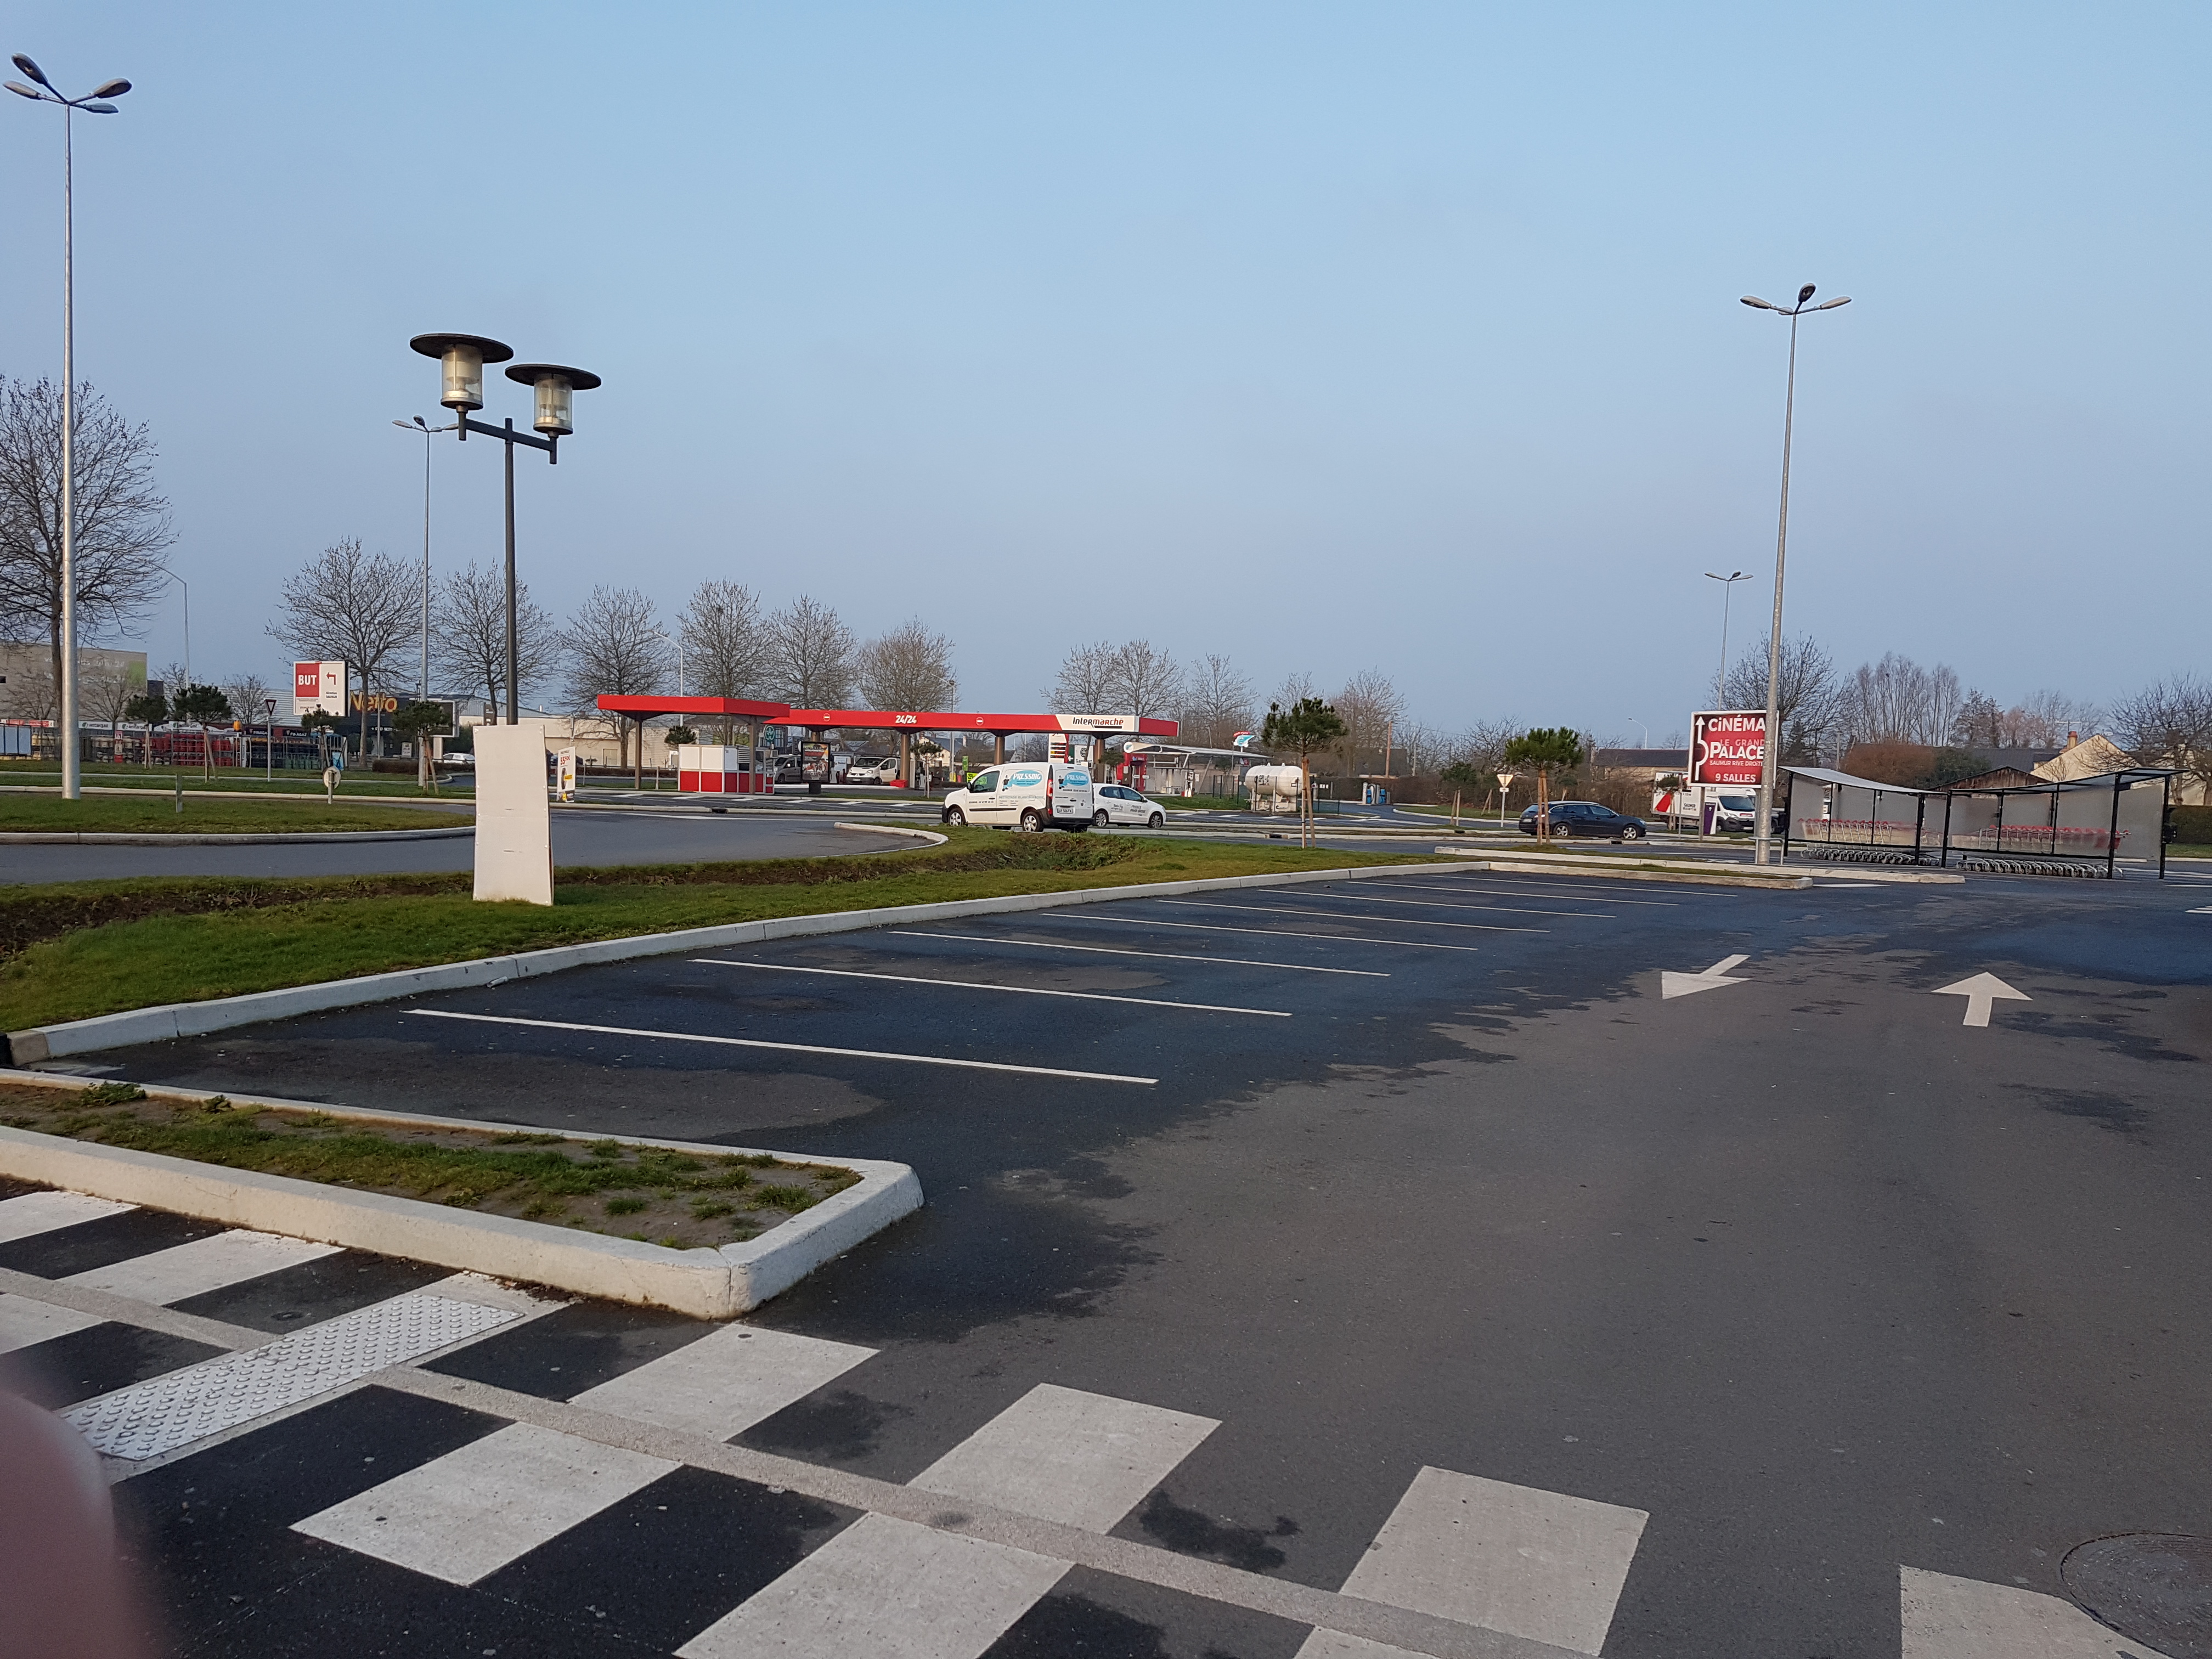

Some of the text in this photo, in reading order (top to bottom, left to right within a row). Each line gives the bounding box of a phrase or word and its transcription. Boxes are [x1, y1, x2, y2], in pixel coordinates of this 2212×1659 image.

[298, 675, 317, 685] BUT
[349, 691, 398, 713] Netto
[895, 715, 917, 724] 24/24
[1073, 717, 1124, 728] Intermarché
[1715, 773, 1756, 783] 9 SALLES
